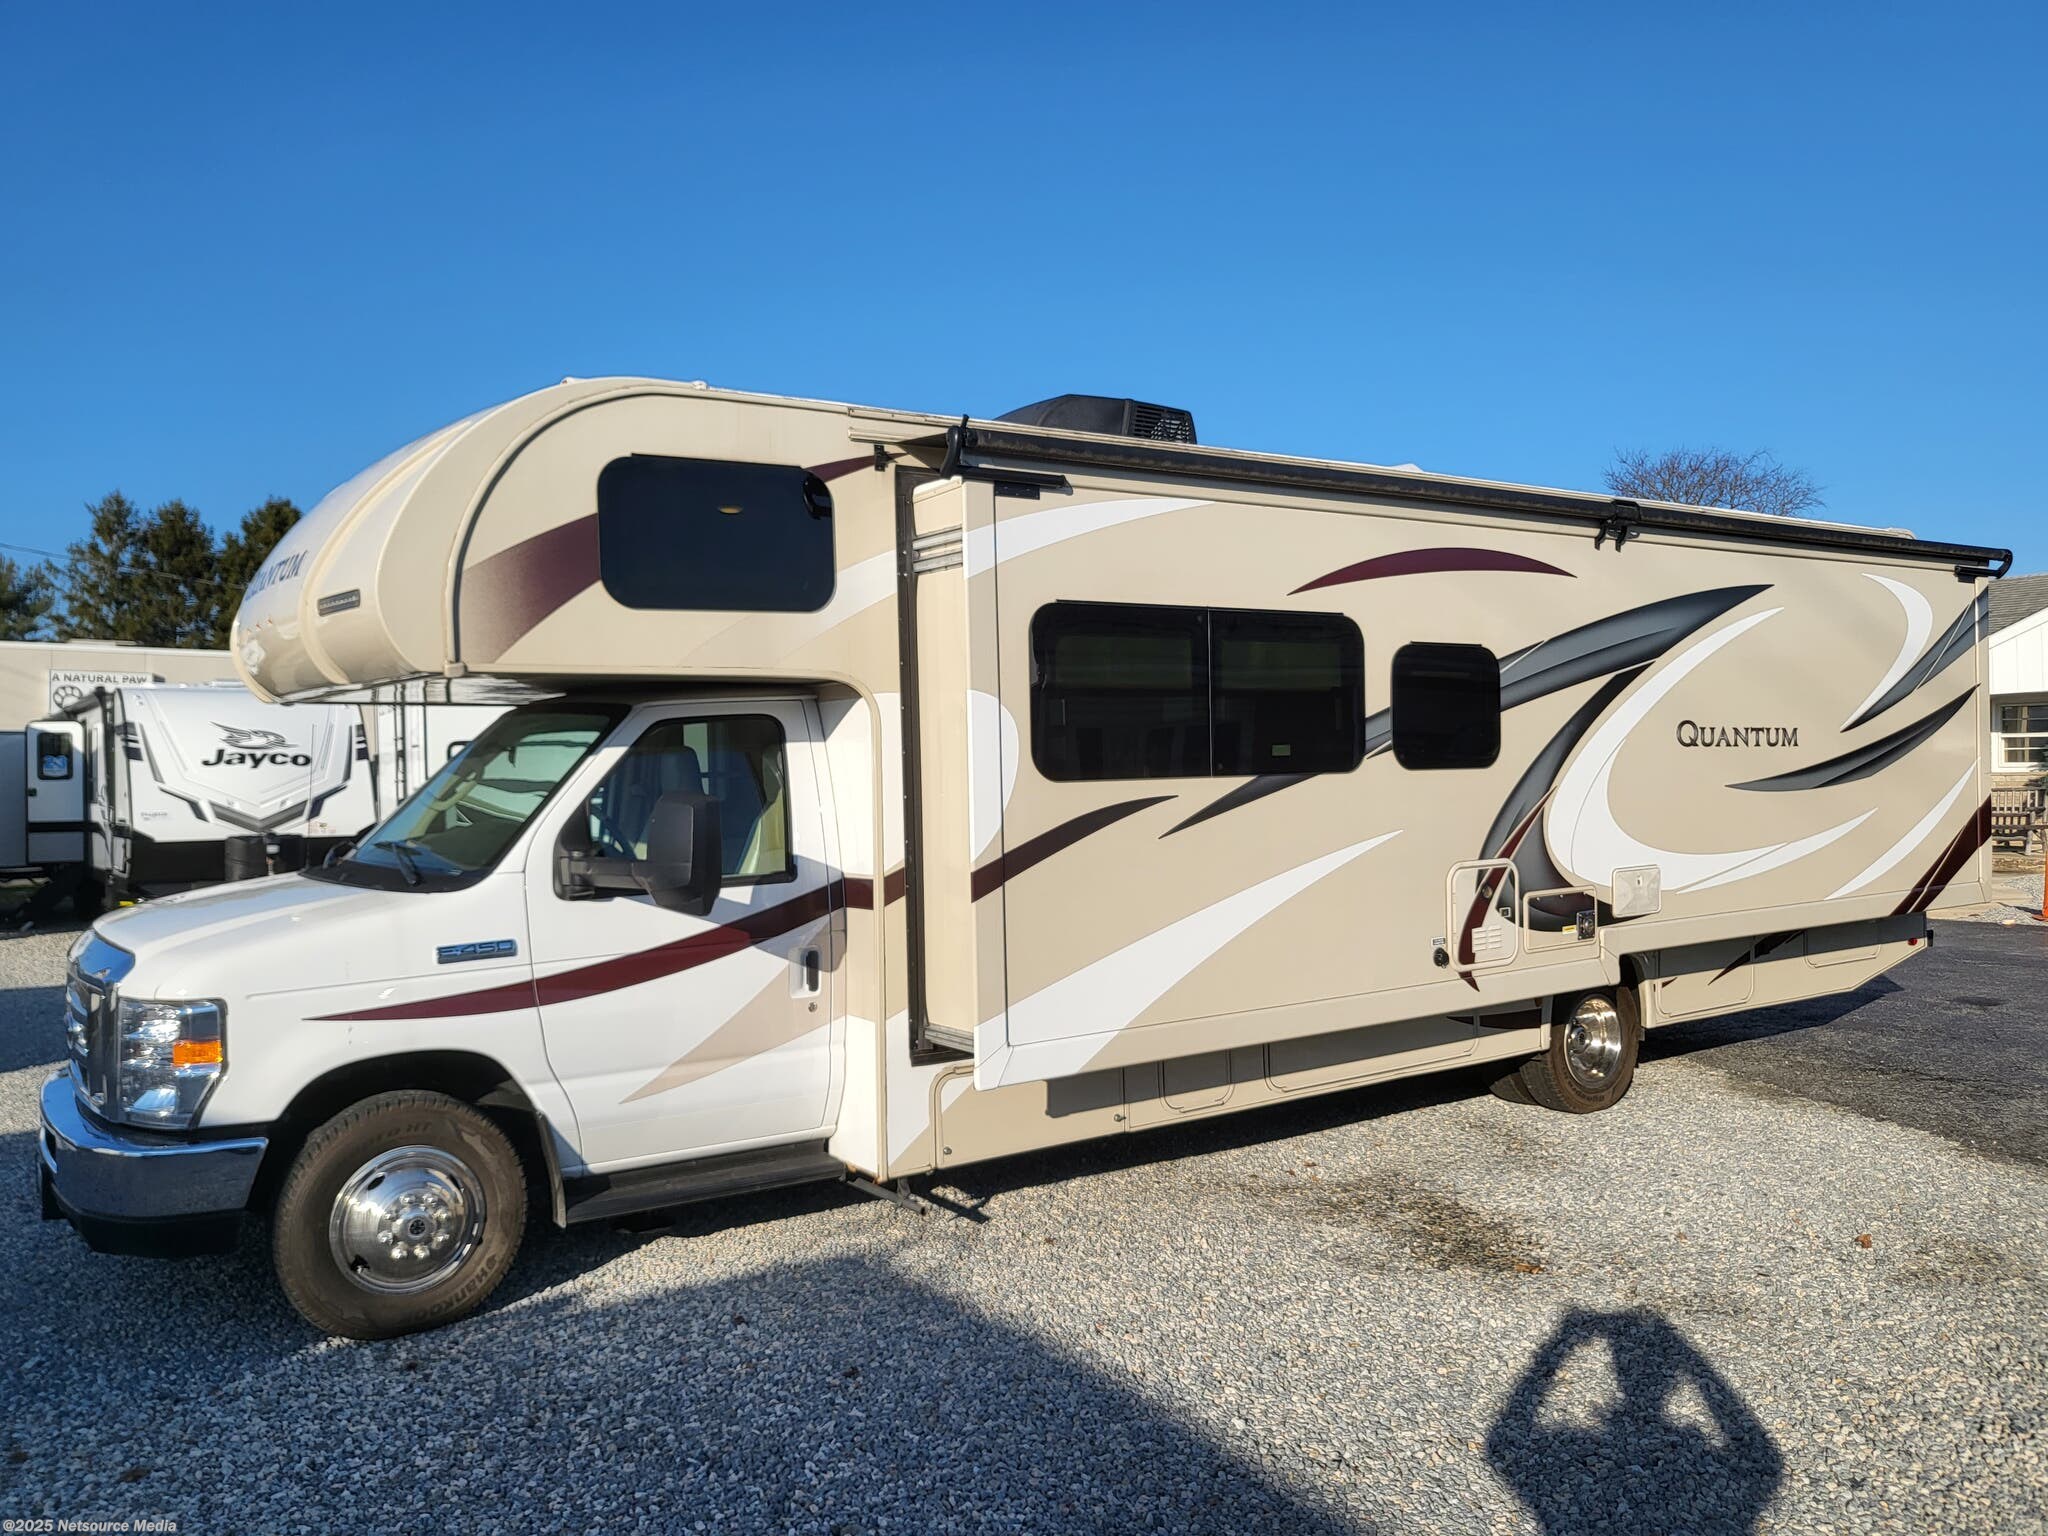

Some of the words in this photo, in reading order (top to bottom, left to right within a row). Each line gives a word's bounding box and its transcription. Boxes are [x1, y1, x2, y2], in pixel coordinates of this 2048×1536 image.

[52, 673, 60, 681] A
[63, 673, 120, 683] NATURAL
[122, 675, 147, 684] PAW
[1676, 720, 1799, 748] QUANTUM
[201, 749, 312, 769] Jayco
